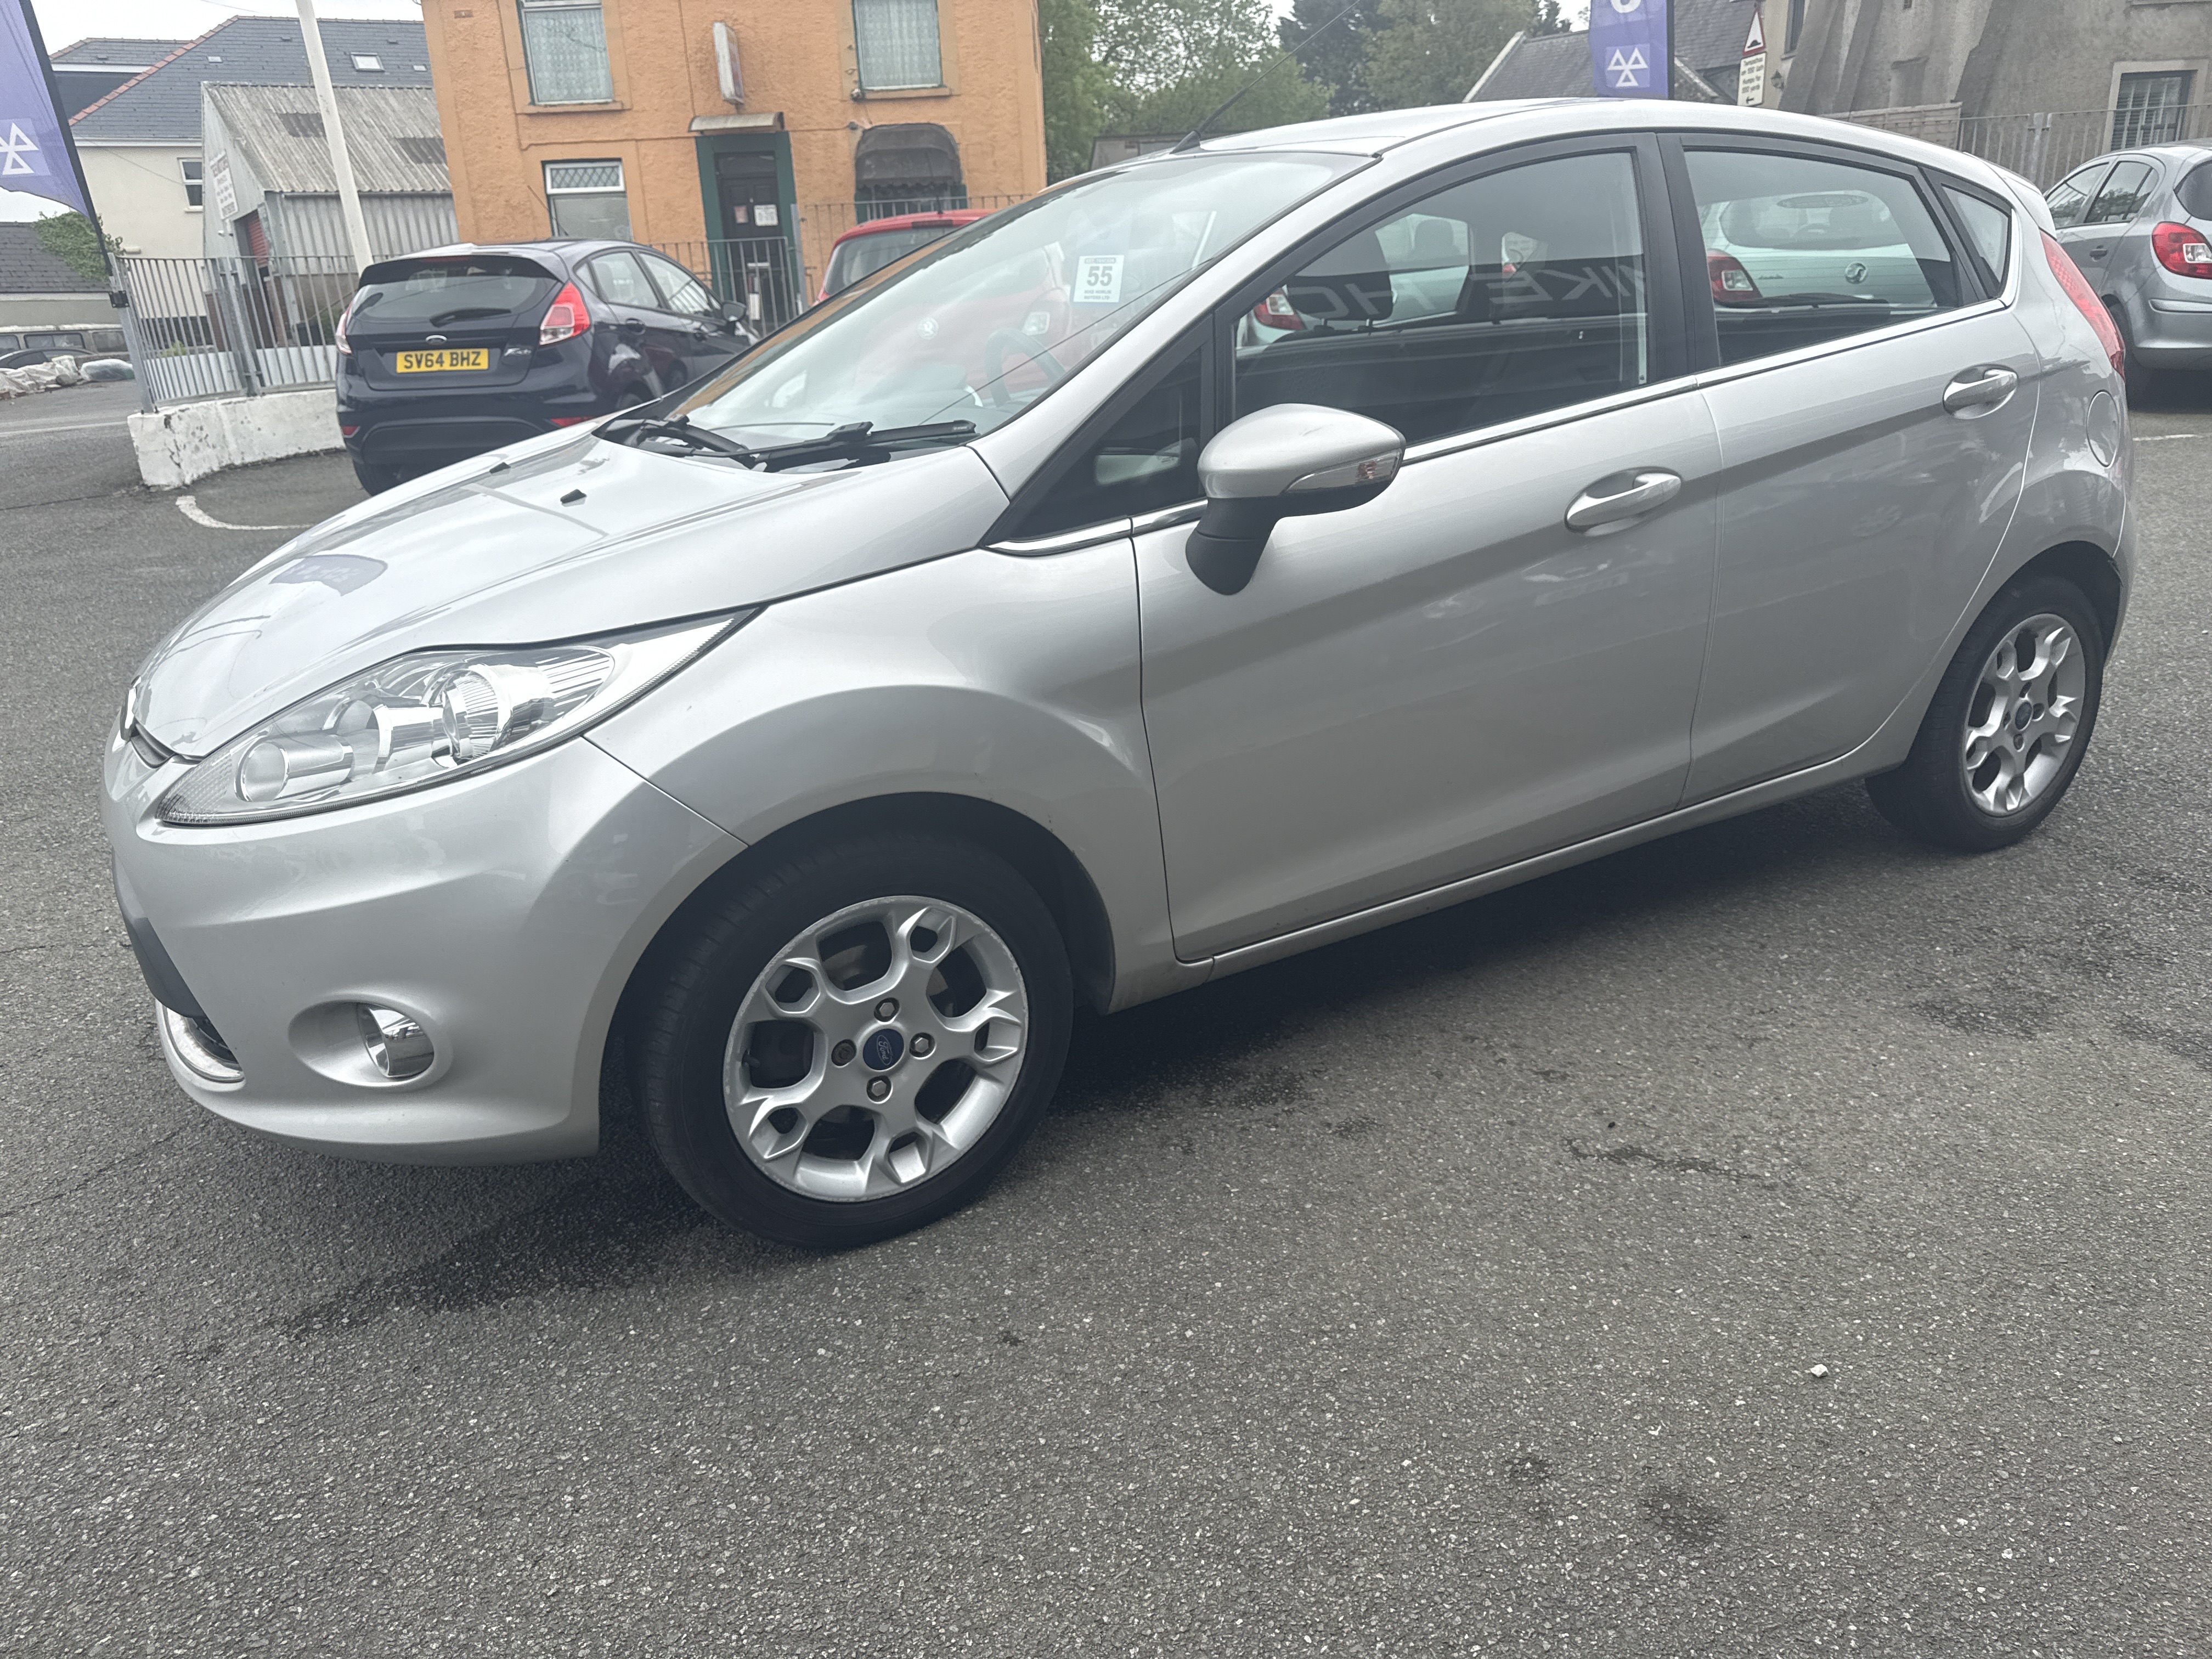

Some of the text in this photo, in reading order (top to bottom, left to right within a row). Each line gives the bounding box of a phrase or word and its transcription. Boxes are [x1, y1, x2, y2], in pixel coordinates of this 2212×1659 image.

[1087, 266, 1113, 286] 55
[404, 351, 481, 369] SV64 BHZ
[878, 1040, 890, 1062] Ford
